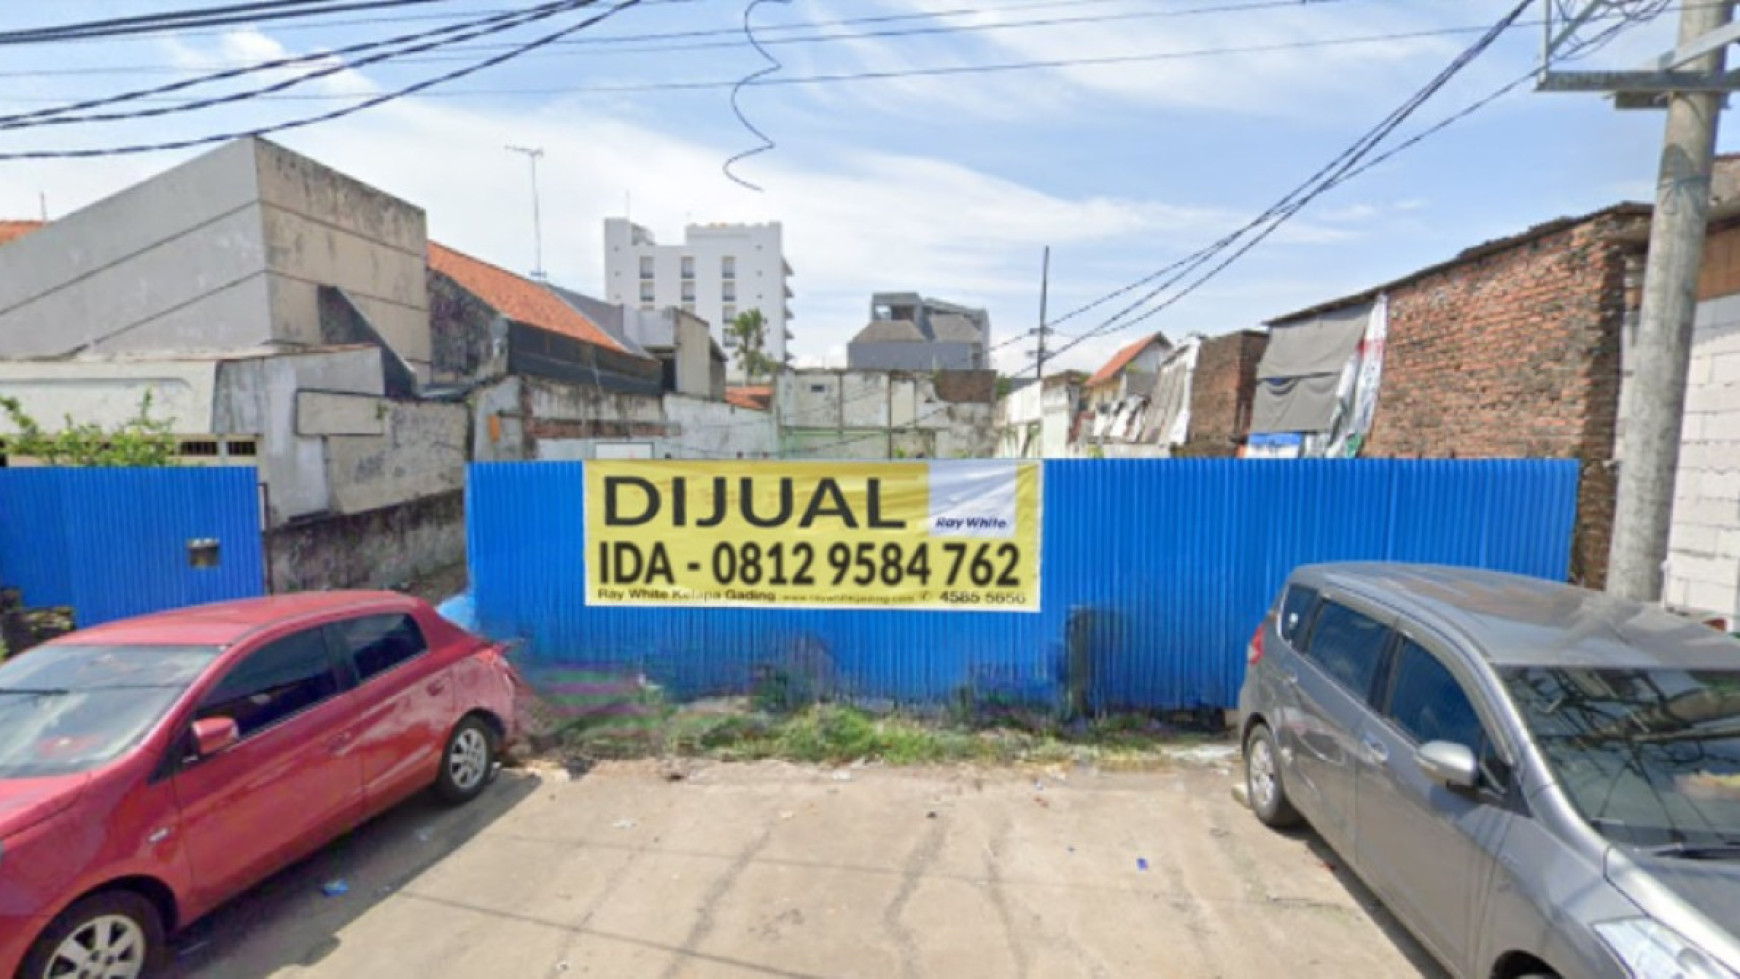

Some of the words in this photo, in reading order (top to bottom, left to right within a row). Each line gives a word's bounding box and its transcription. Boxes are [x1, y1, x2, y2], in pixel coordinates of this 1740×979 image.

[604, 476, 906, 529] DIJUAL
[935, 517, 965, 530] Ray
[966, 516, 1007, 529] White
[599, 541, 675, 585] IDA
[687, 561, 701, 571] -
[712, 541, 816, 586] 0812
[827, 541, 931, 587] 9584
[942, 542, 1021, 587] 762
[598, 588, 624, 600] Ray
[628, 588, 669, 600] White
[725, 589, 777, 602] Gading
